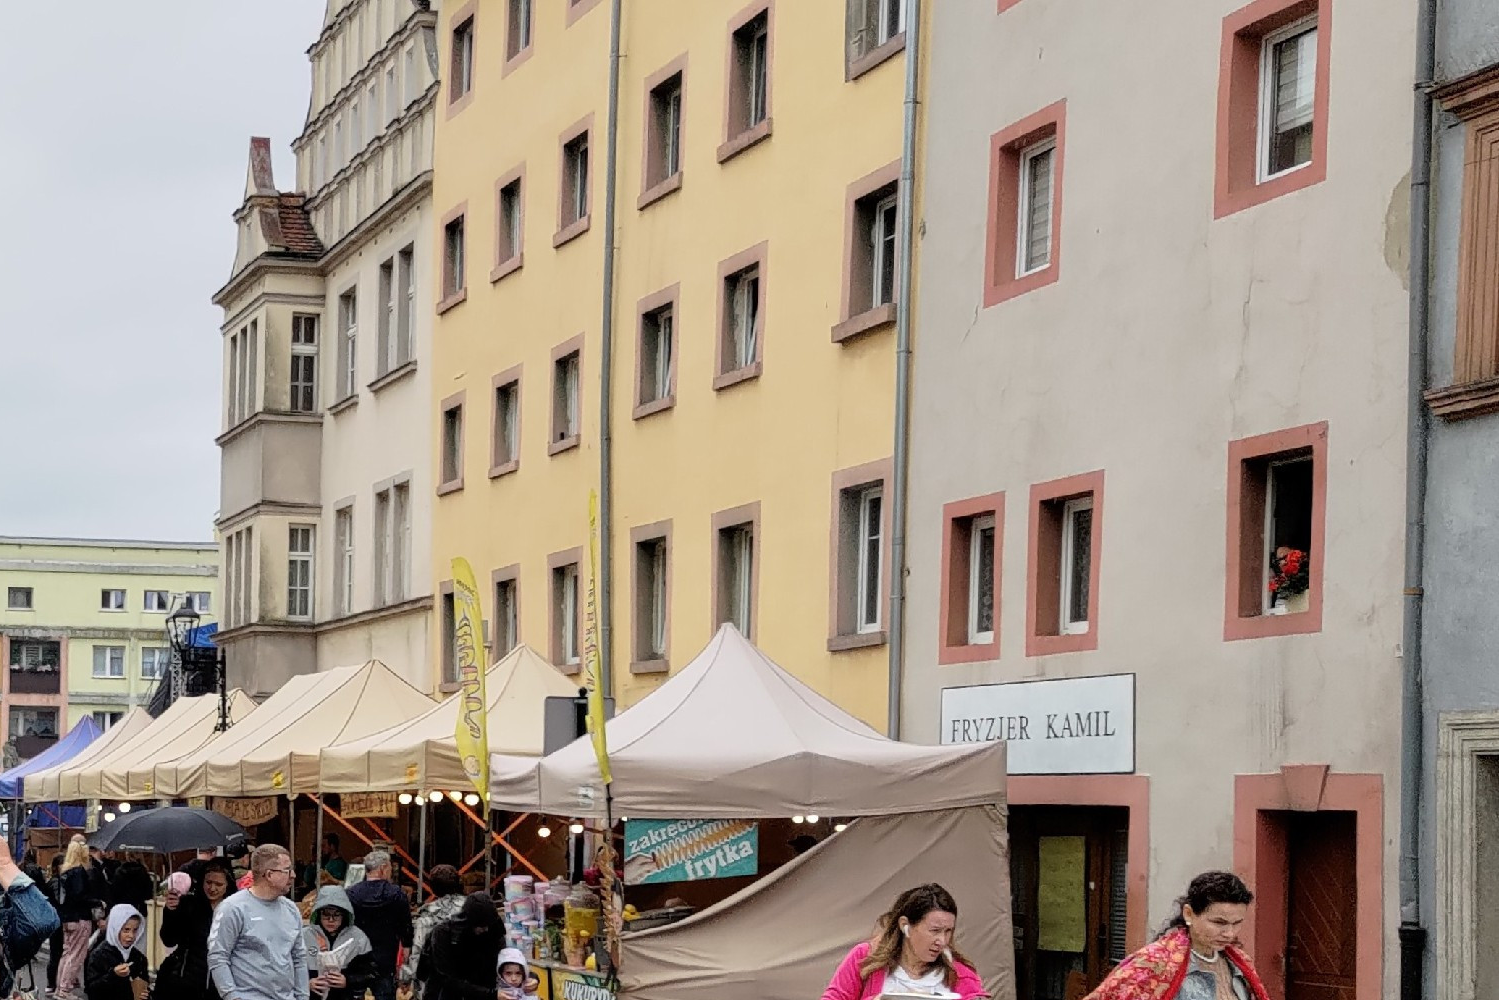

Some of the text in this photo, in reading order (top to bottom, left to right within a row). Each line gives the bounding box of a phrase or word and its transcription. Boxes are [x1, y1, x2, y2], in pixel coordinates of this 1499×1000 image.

[951, 711, 1116, 743] FRYZJER KAMIL
[629, 820, 703, 853] zakręco
[684, 840, 753, 880] frytka
